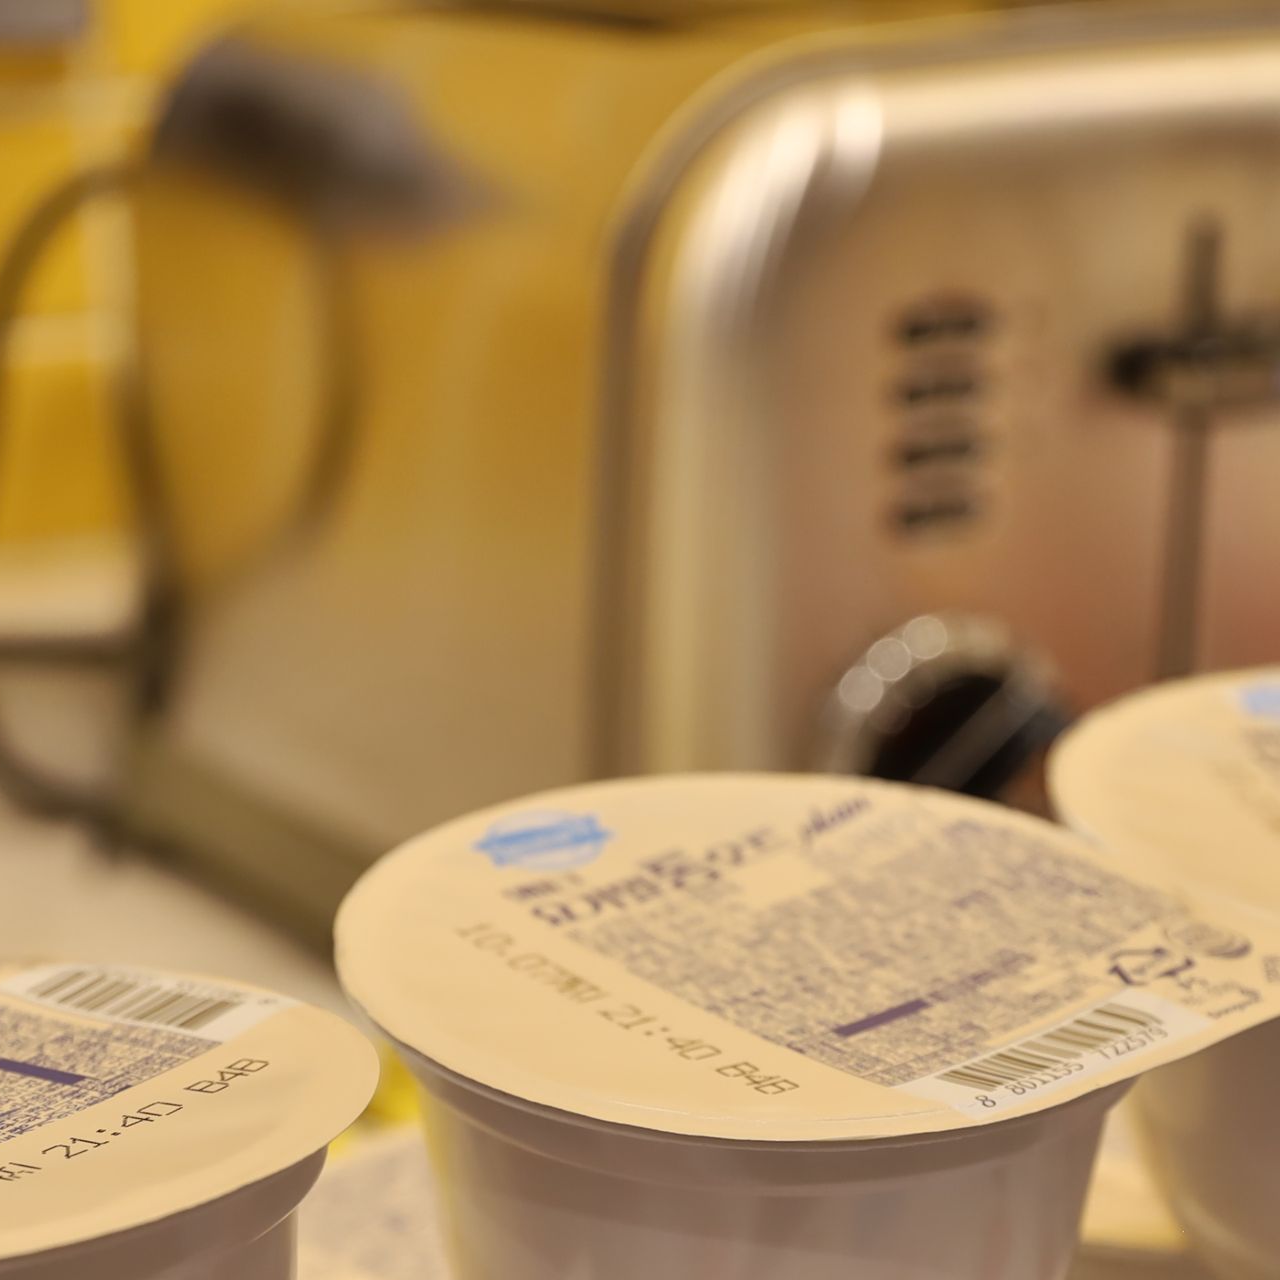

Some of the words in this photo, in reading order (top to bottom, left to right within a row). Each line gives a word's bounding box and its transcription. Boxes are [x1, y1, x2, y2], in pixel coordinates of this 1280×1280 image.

[597, 1003, 721, 1061] 21:40
[715, 1061, 800, 1095] B4B
[974, 1094, 998, 1109] 8
[1004, 1060, 1085, 1097] 801155
[41, 1100, 185, 1161] 21:40
[184, 1055, 272, 1097] B4B
